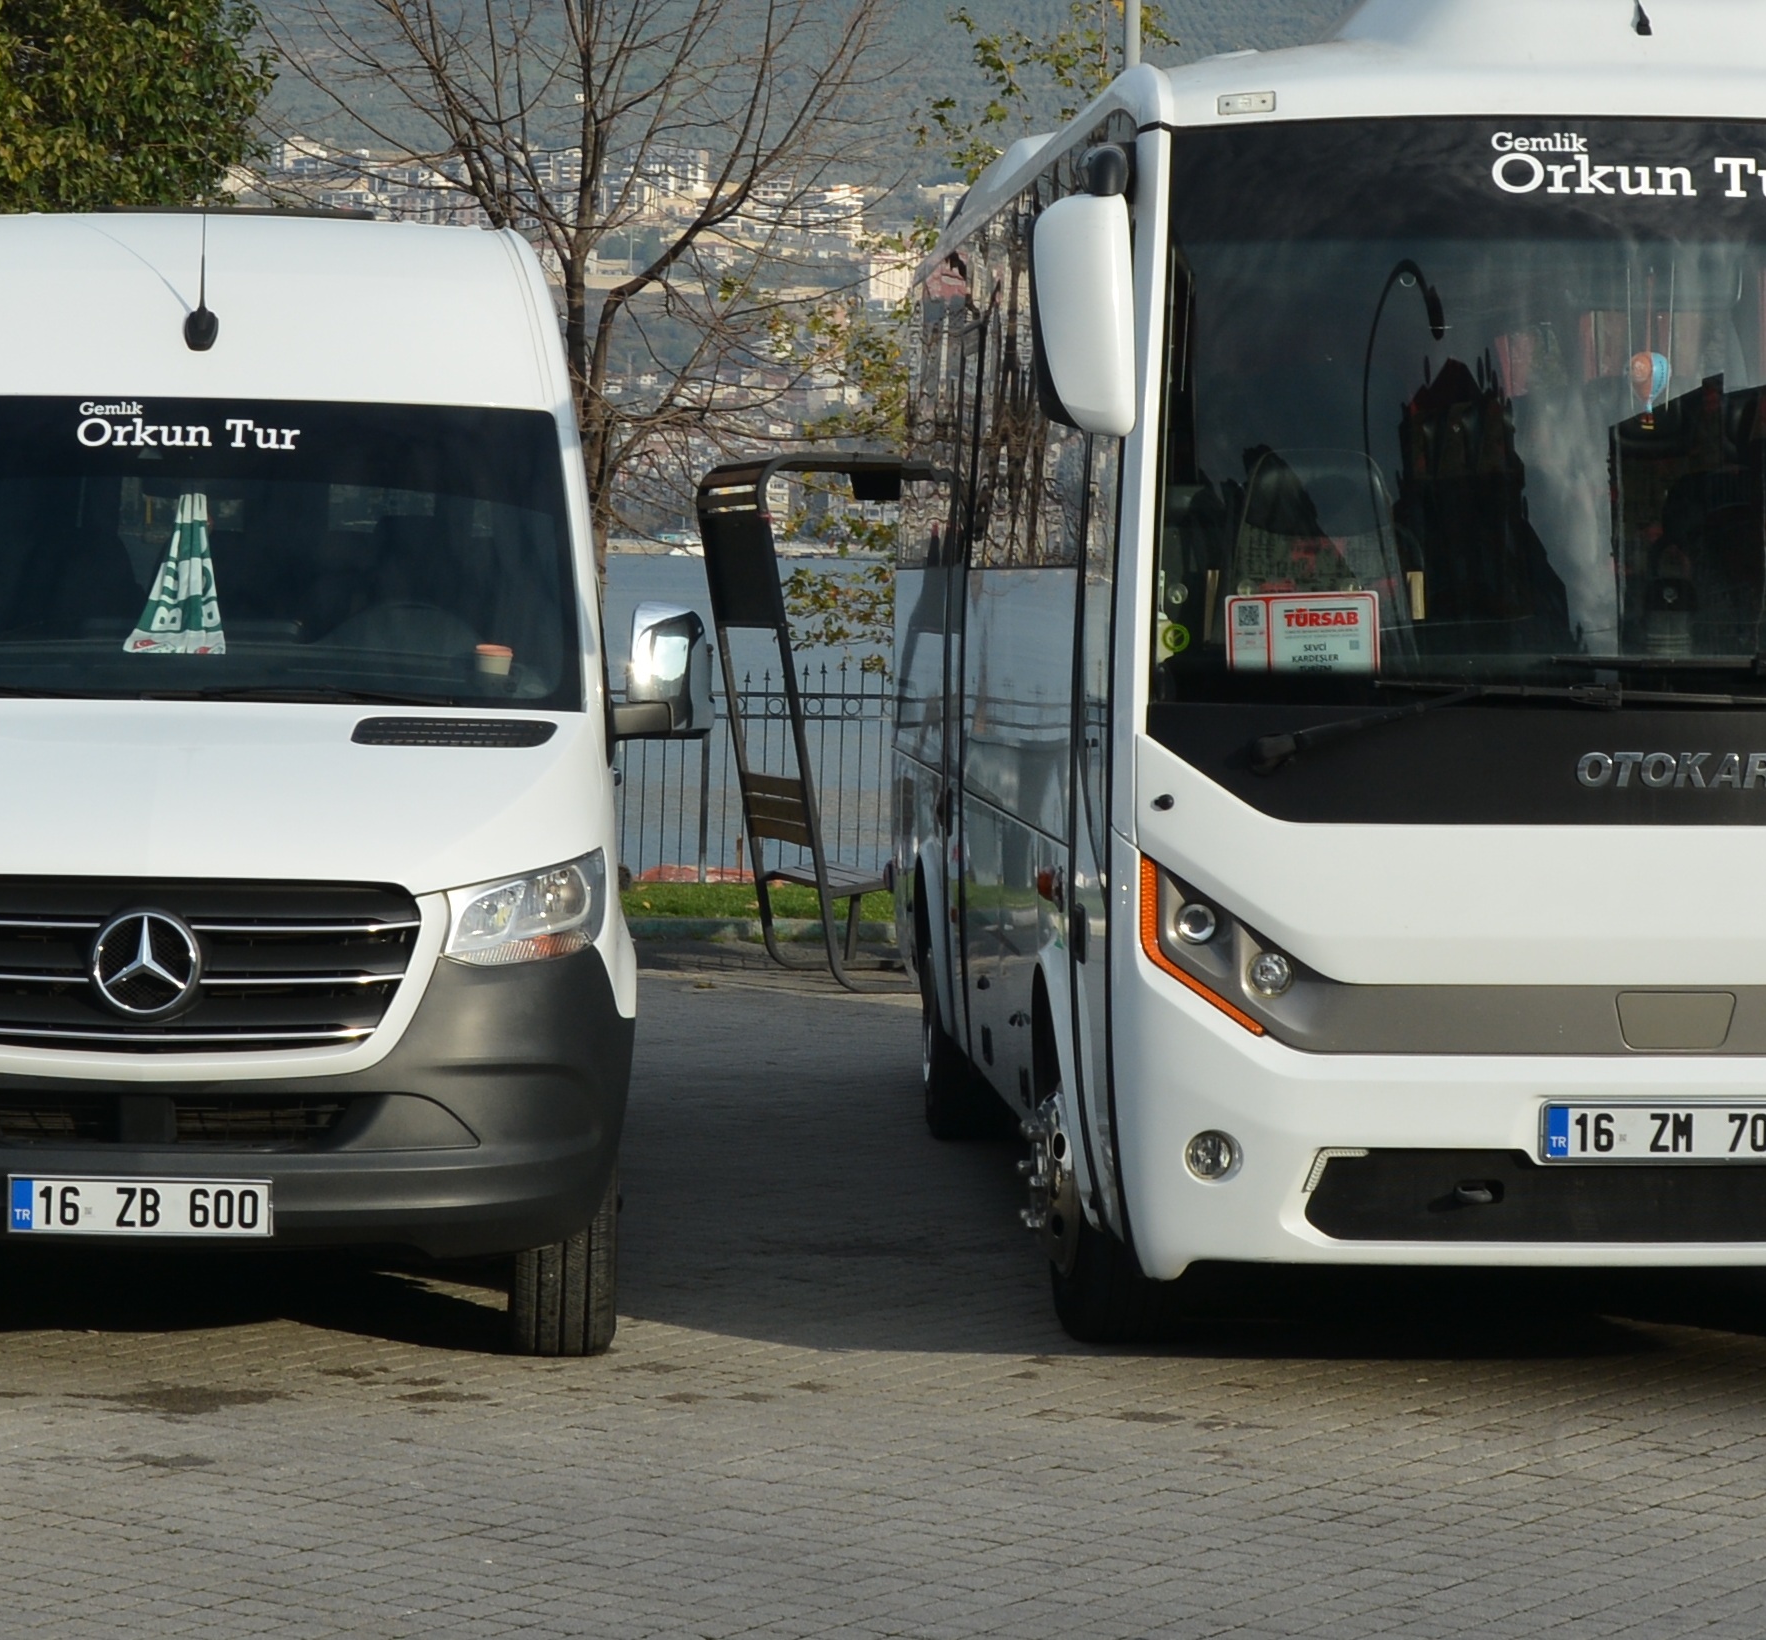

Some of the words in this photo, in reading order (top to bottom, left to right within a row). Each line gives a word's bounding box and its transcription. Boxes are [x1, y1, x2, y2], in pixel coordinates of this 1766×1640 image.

[1491, 131, 1589, 153] Gemlik
[1491, 152, 1698, 197] Orkun
[76, 417, 213, 448] Orkun
[225, 418, 301, 450] Tur
[1284, 608, 1359, 627] TÜRSAB
[1550, 1135, 1568, 1148] TR
[1575, 1112, 1615, 1153] 16
[1649, 1112, 1694, 1153] ZM
[14, 1208, 32, 1221] TR
[39, 1185, 81, 1226] 16
[115, 1187, 162, 1228] ZB
[189, 1188, 260, 1229] 600
